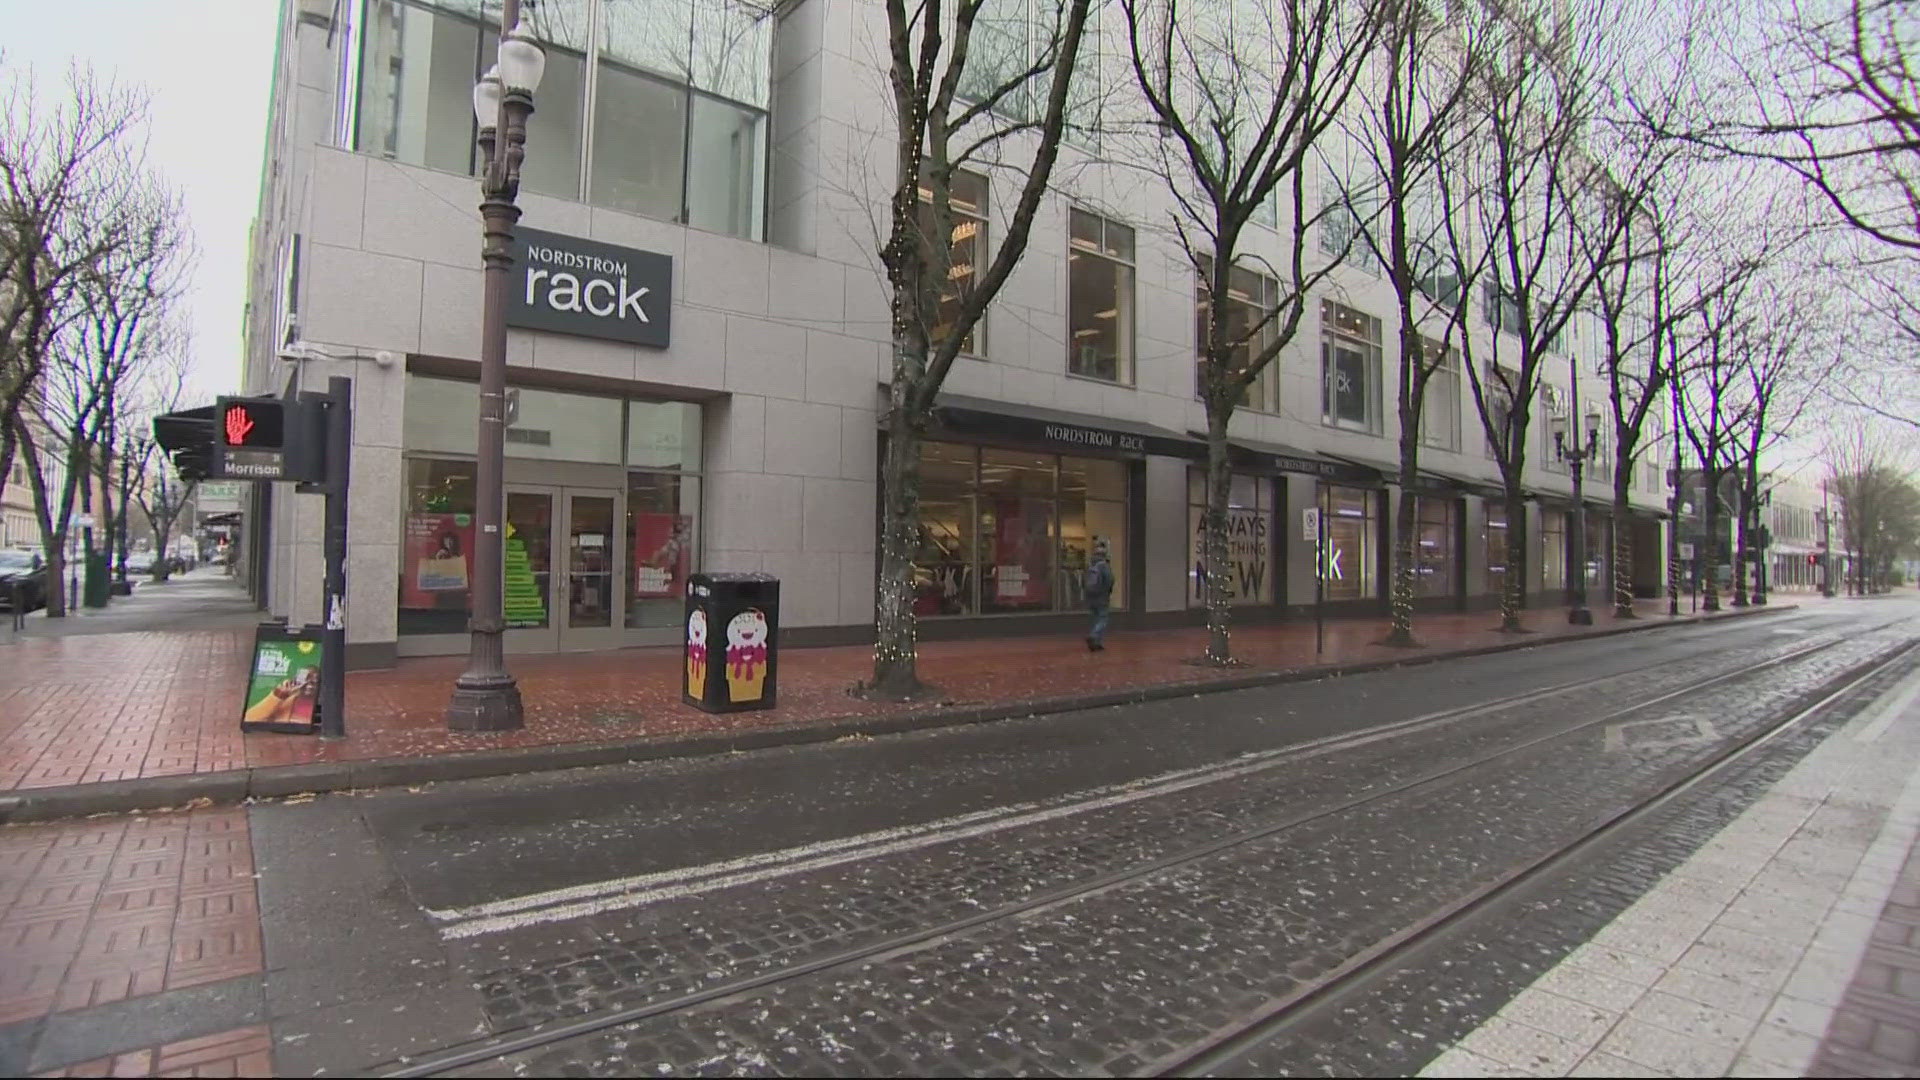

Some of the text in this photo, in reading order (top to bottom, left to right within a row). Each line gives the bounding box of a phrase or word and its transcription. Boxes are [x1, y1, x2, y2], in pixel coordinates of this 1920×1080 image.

[528, 245, 627, 276] NORDSTROM
[526, 267, 649, 323] rack
[1045, 424, 1113, 447] NORDSTROM
[224, 462, 280, 475] Morrison
[1196, 514, 1266, 537] AWAYS
[1196, 540, 1266, 556] STHING
